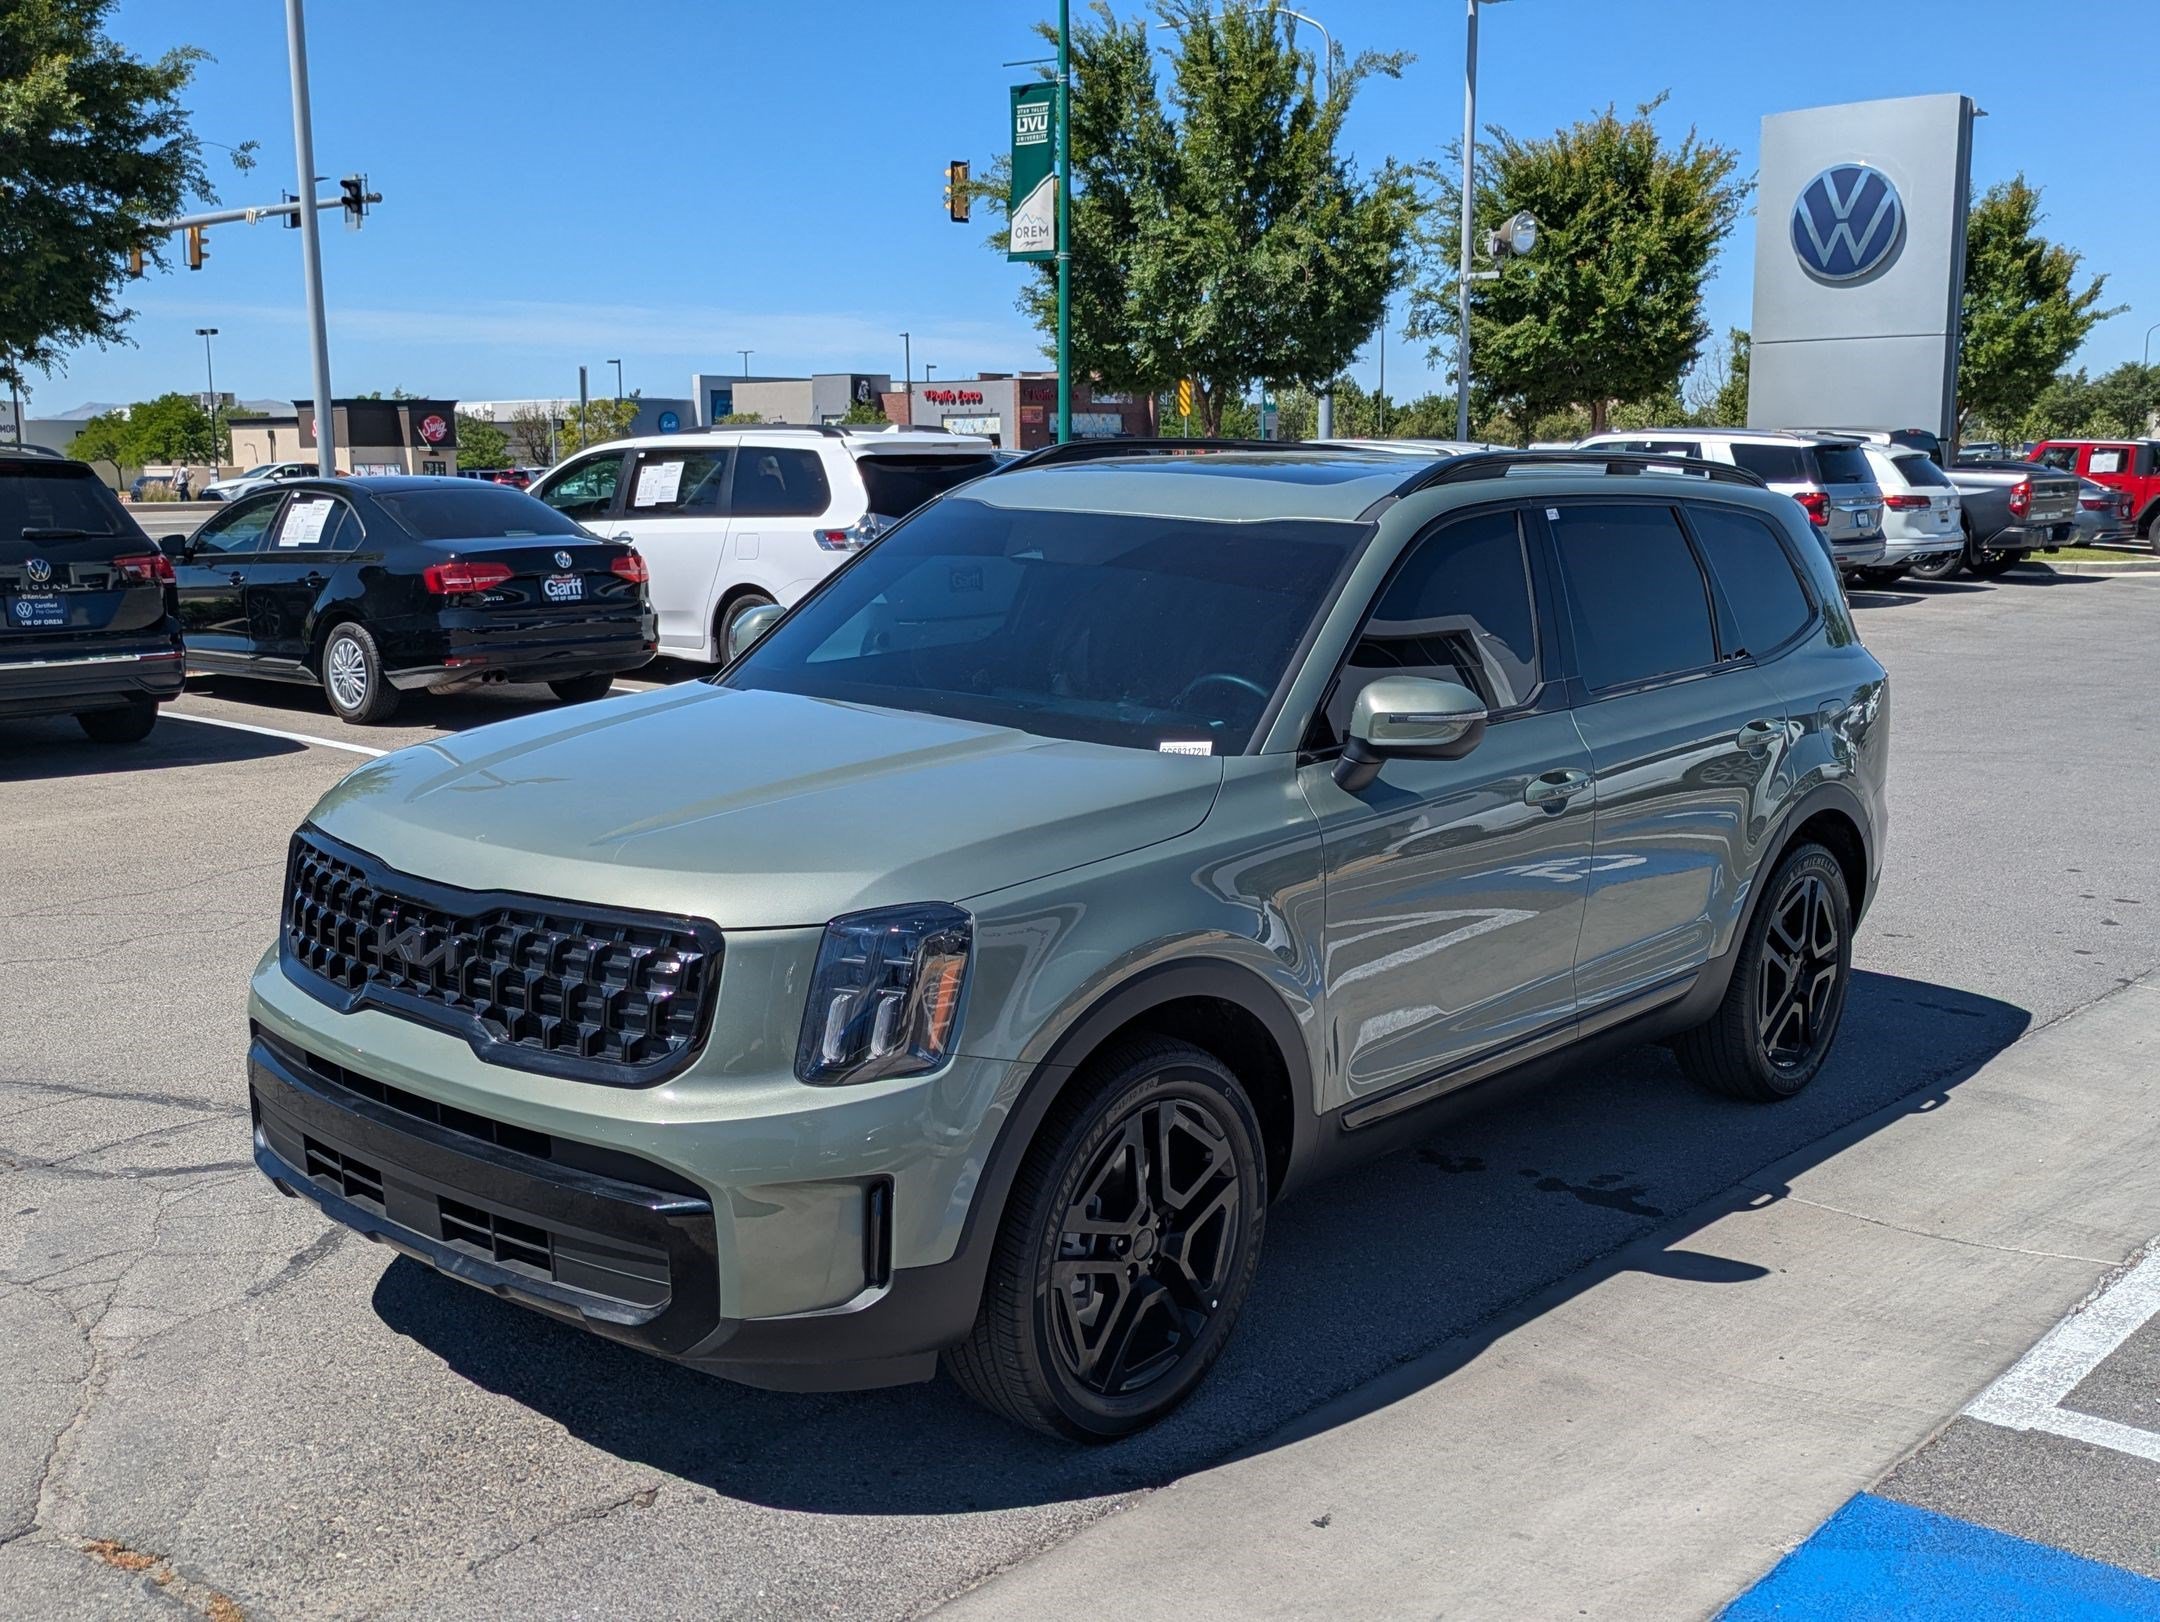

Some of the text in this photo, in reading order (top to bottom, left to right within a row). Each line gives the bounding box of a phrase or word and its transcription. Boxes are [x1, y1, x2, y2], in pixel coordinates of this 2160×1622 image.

[1017, 115, 1048, 132] UVU
[1016, 133, 1048, 142] UNIVERSITY
[1015, 225, 1050, 239] OREM
[930, 390, 954, 400] Pollo
[956, 390, 981, 400] Loco
[422, 418, 448, 438] Swig
[14, 583, 69, 591] TIGUAN
[544, 578, 582, 596] Garff
[1803, 857, 1836, 874] MICHELIN
[1046, 1123, 1104, 1247] MICHELIN
